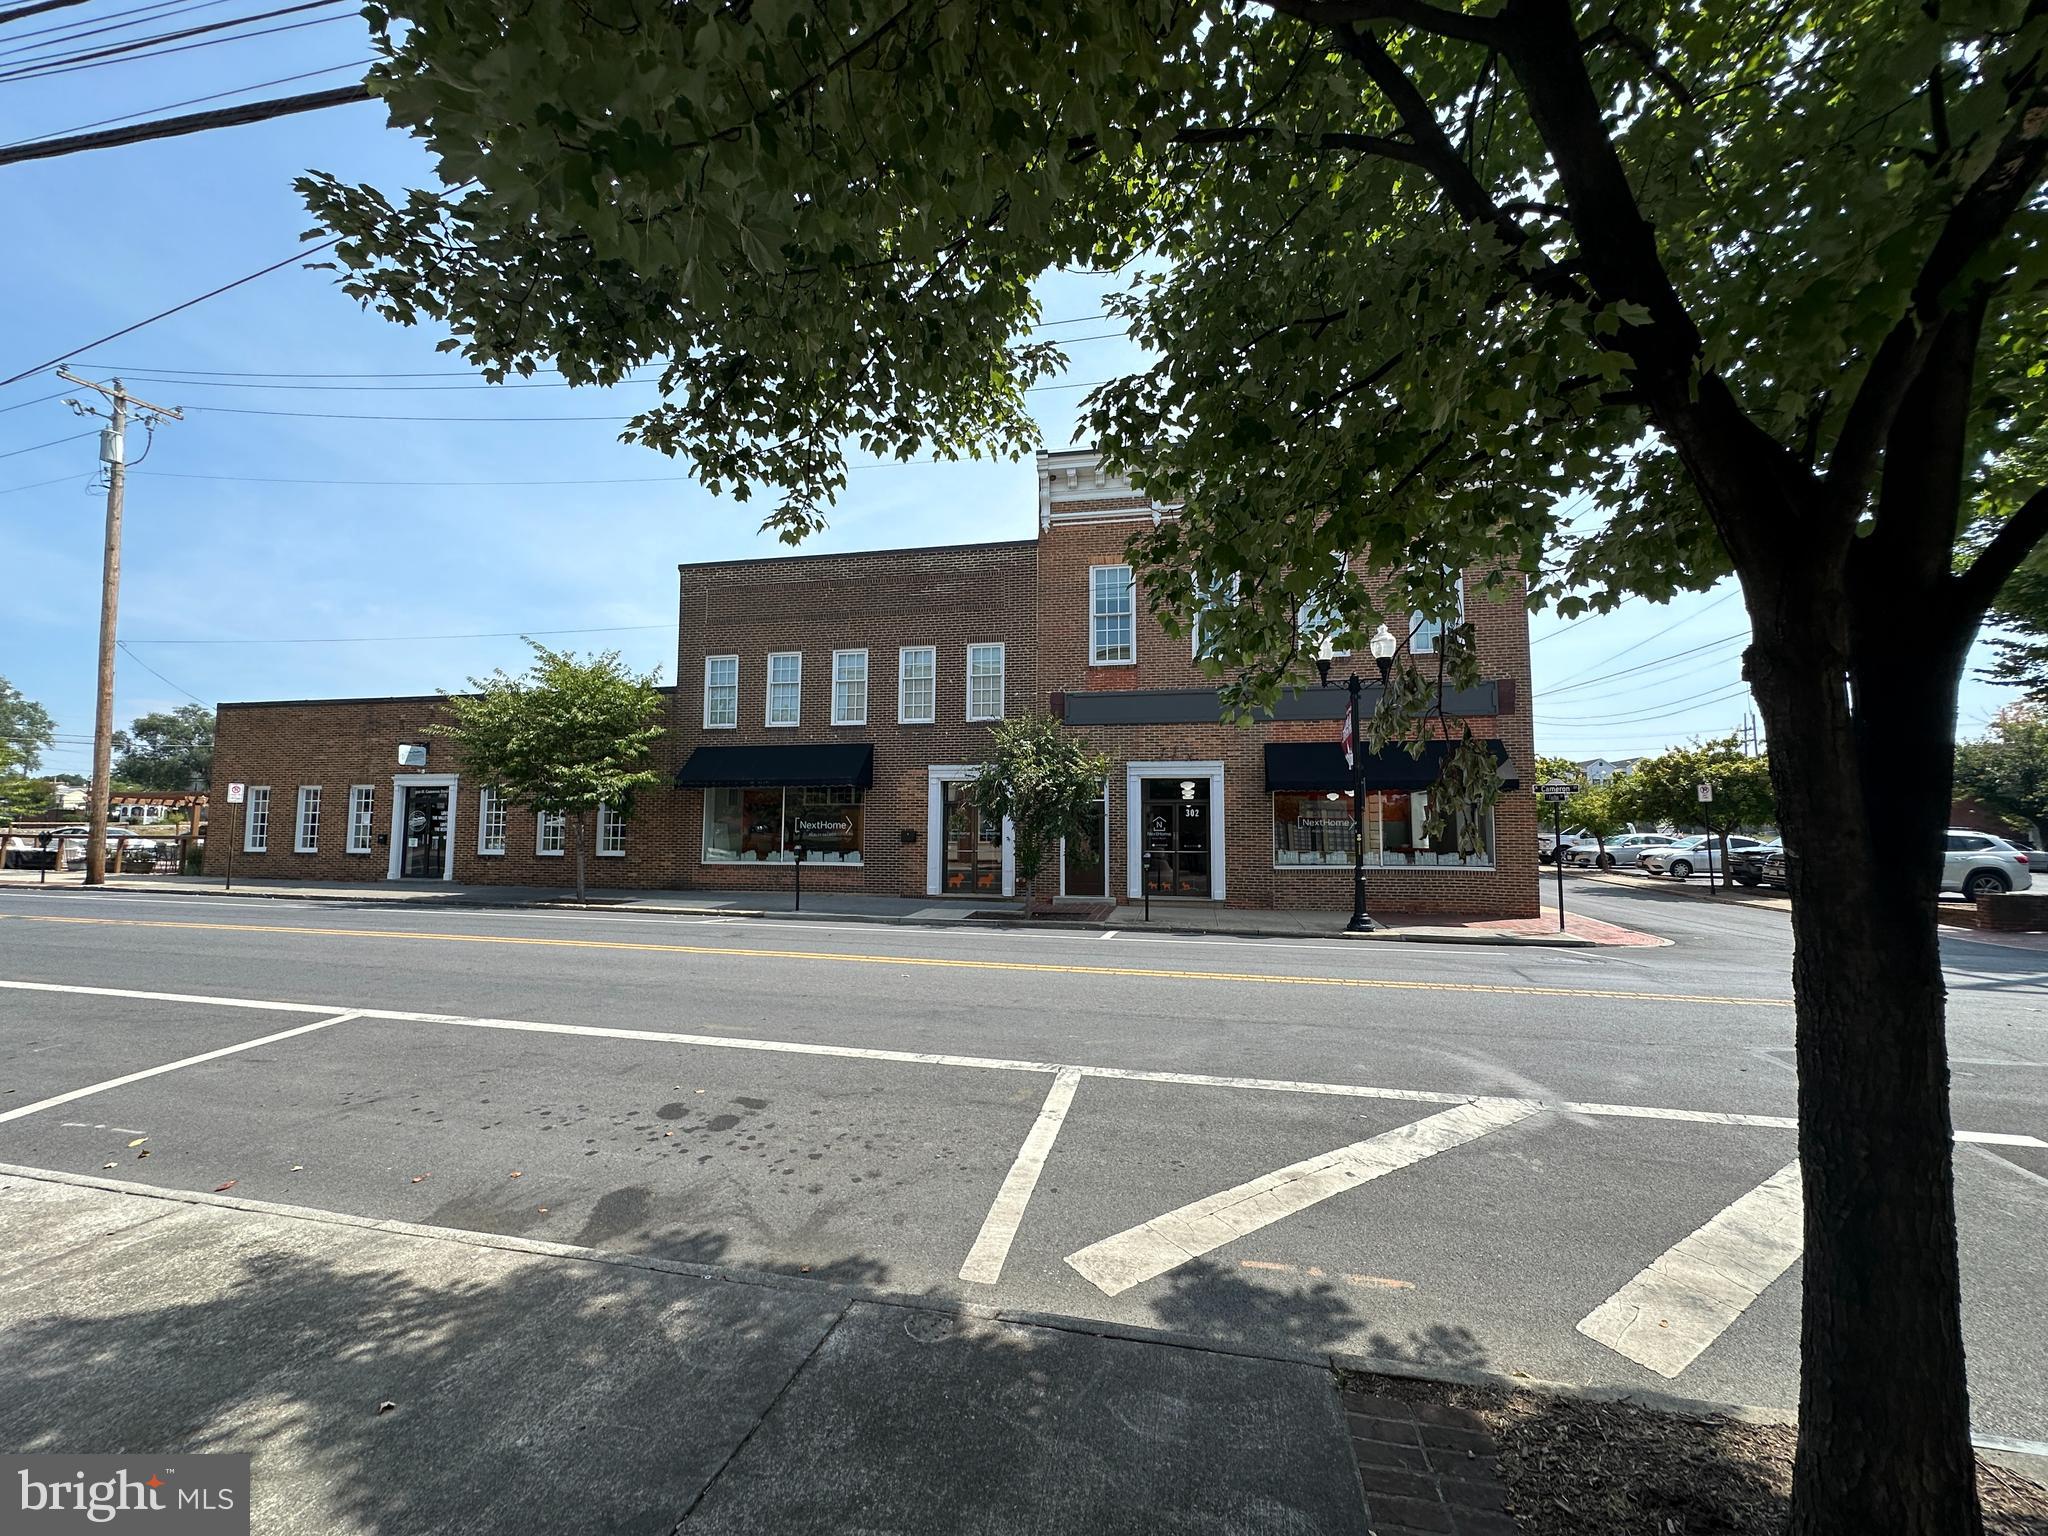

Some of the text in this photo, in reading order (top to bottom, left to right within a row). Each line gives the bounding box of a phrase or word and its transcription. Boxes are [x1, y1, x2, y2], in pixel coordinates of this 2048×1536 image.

[1541, 785, 1571, 793] Cameron
[1185, 808, 1200, 817] 302
[800, 820, 847, 830] NextHome
[1302, 818, 1350, 827] NextHome
